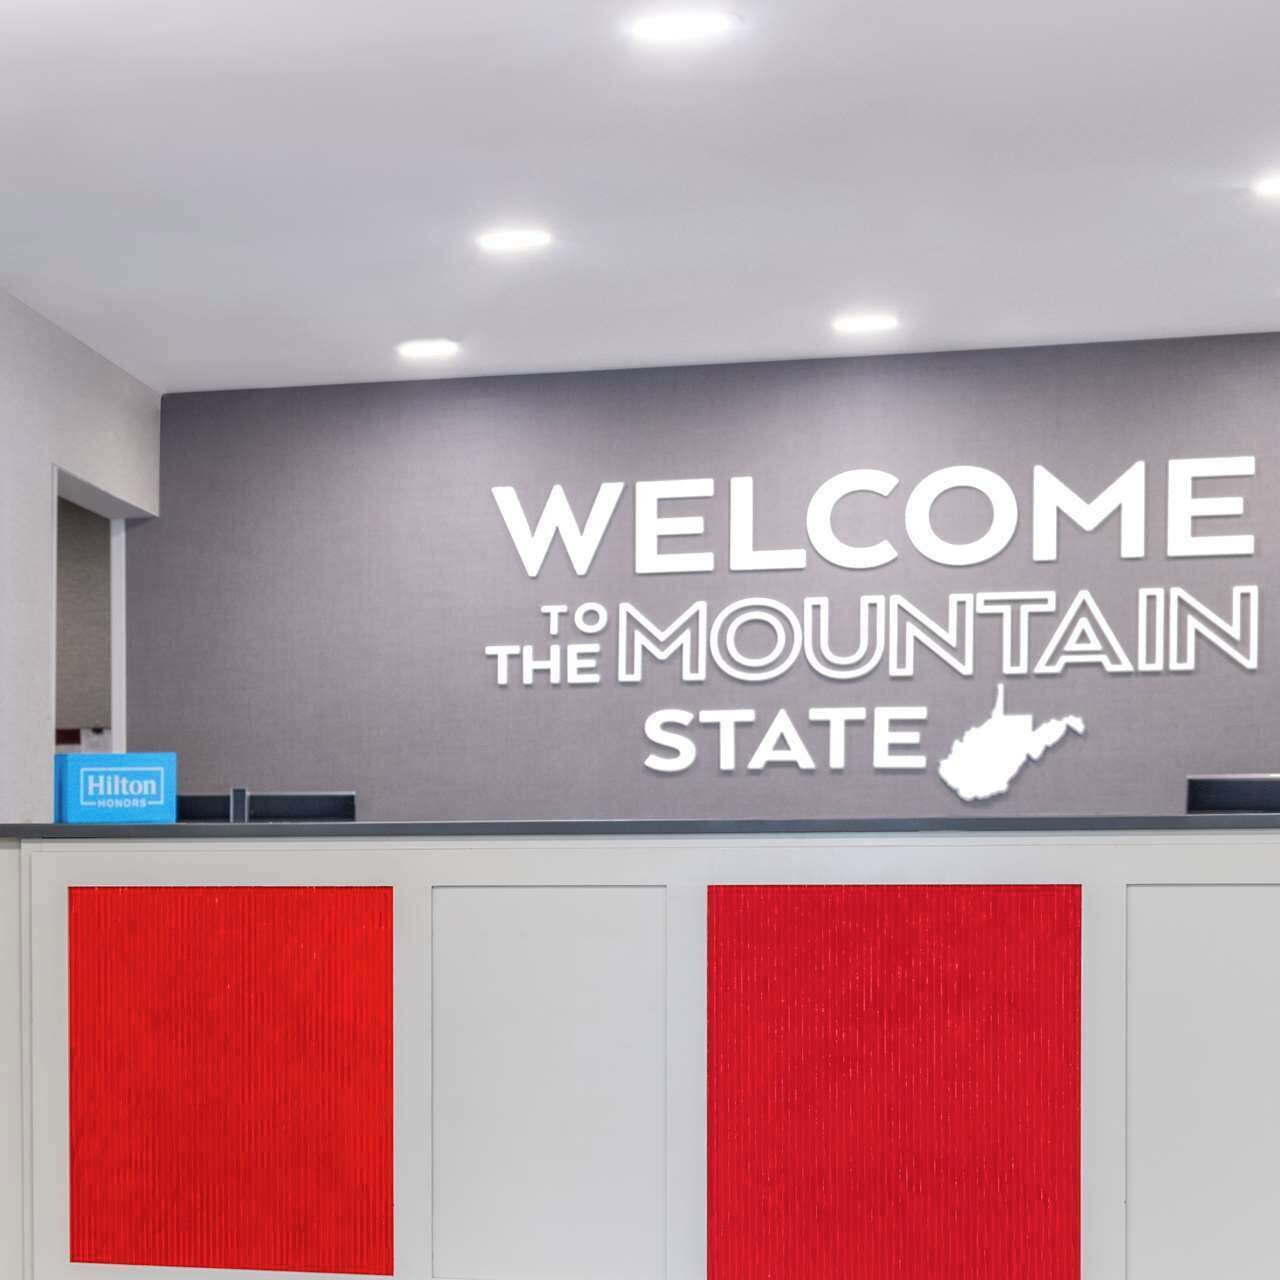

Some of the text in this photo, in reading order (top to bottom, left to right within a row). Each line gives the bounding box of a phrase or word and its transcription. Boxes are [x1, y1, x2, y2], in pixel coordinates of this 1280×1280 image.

[491, 455, 1256, 578] WELCOME
[485, 585, 1260, 685] THE MOUNTAIN
[540, 602, 608, 635] TO
[643, 706, 928, 773] STATE
[87, 775, 157, 796] Hilton
